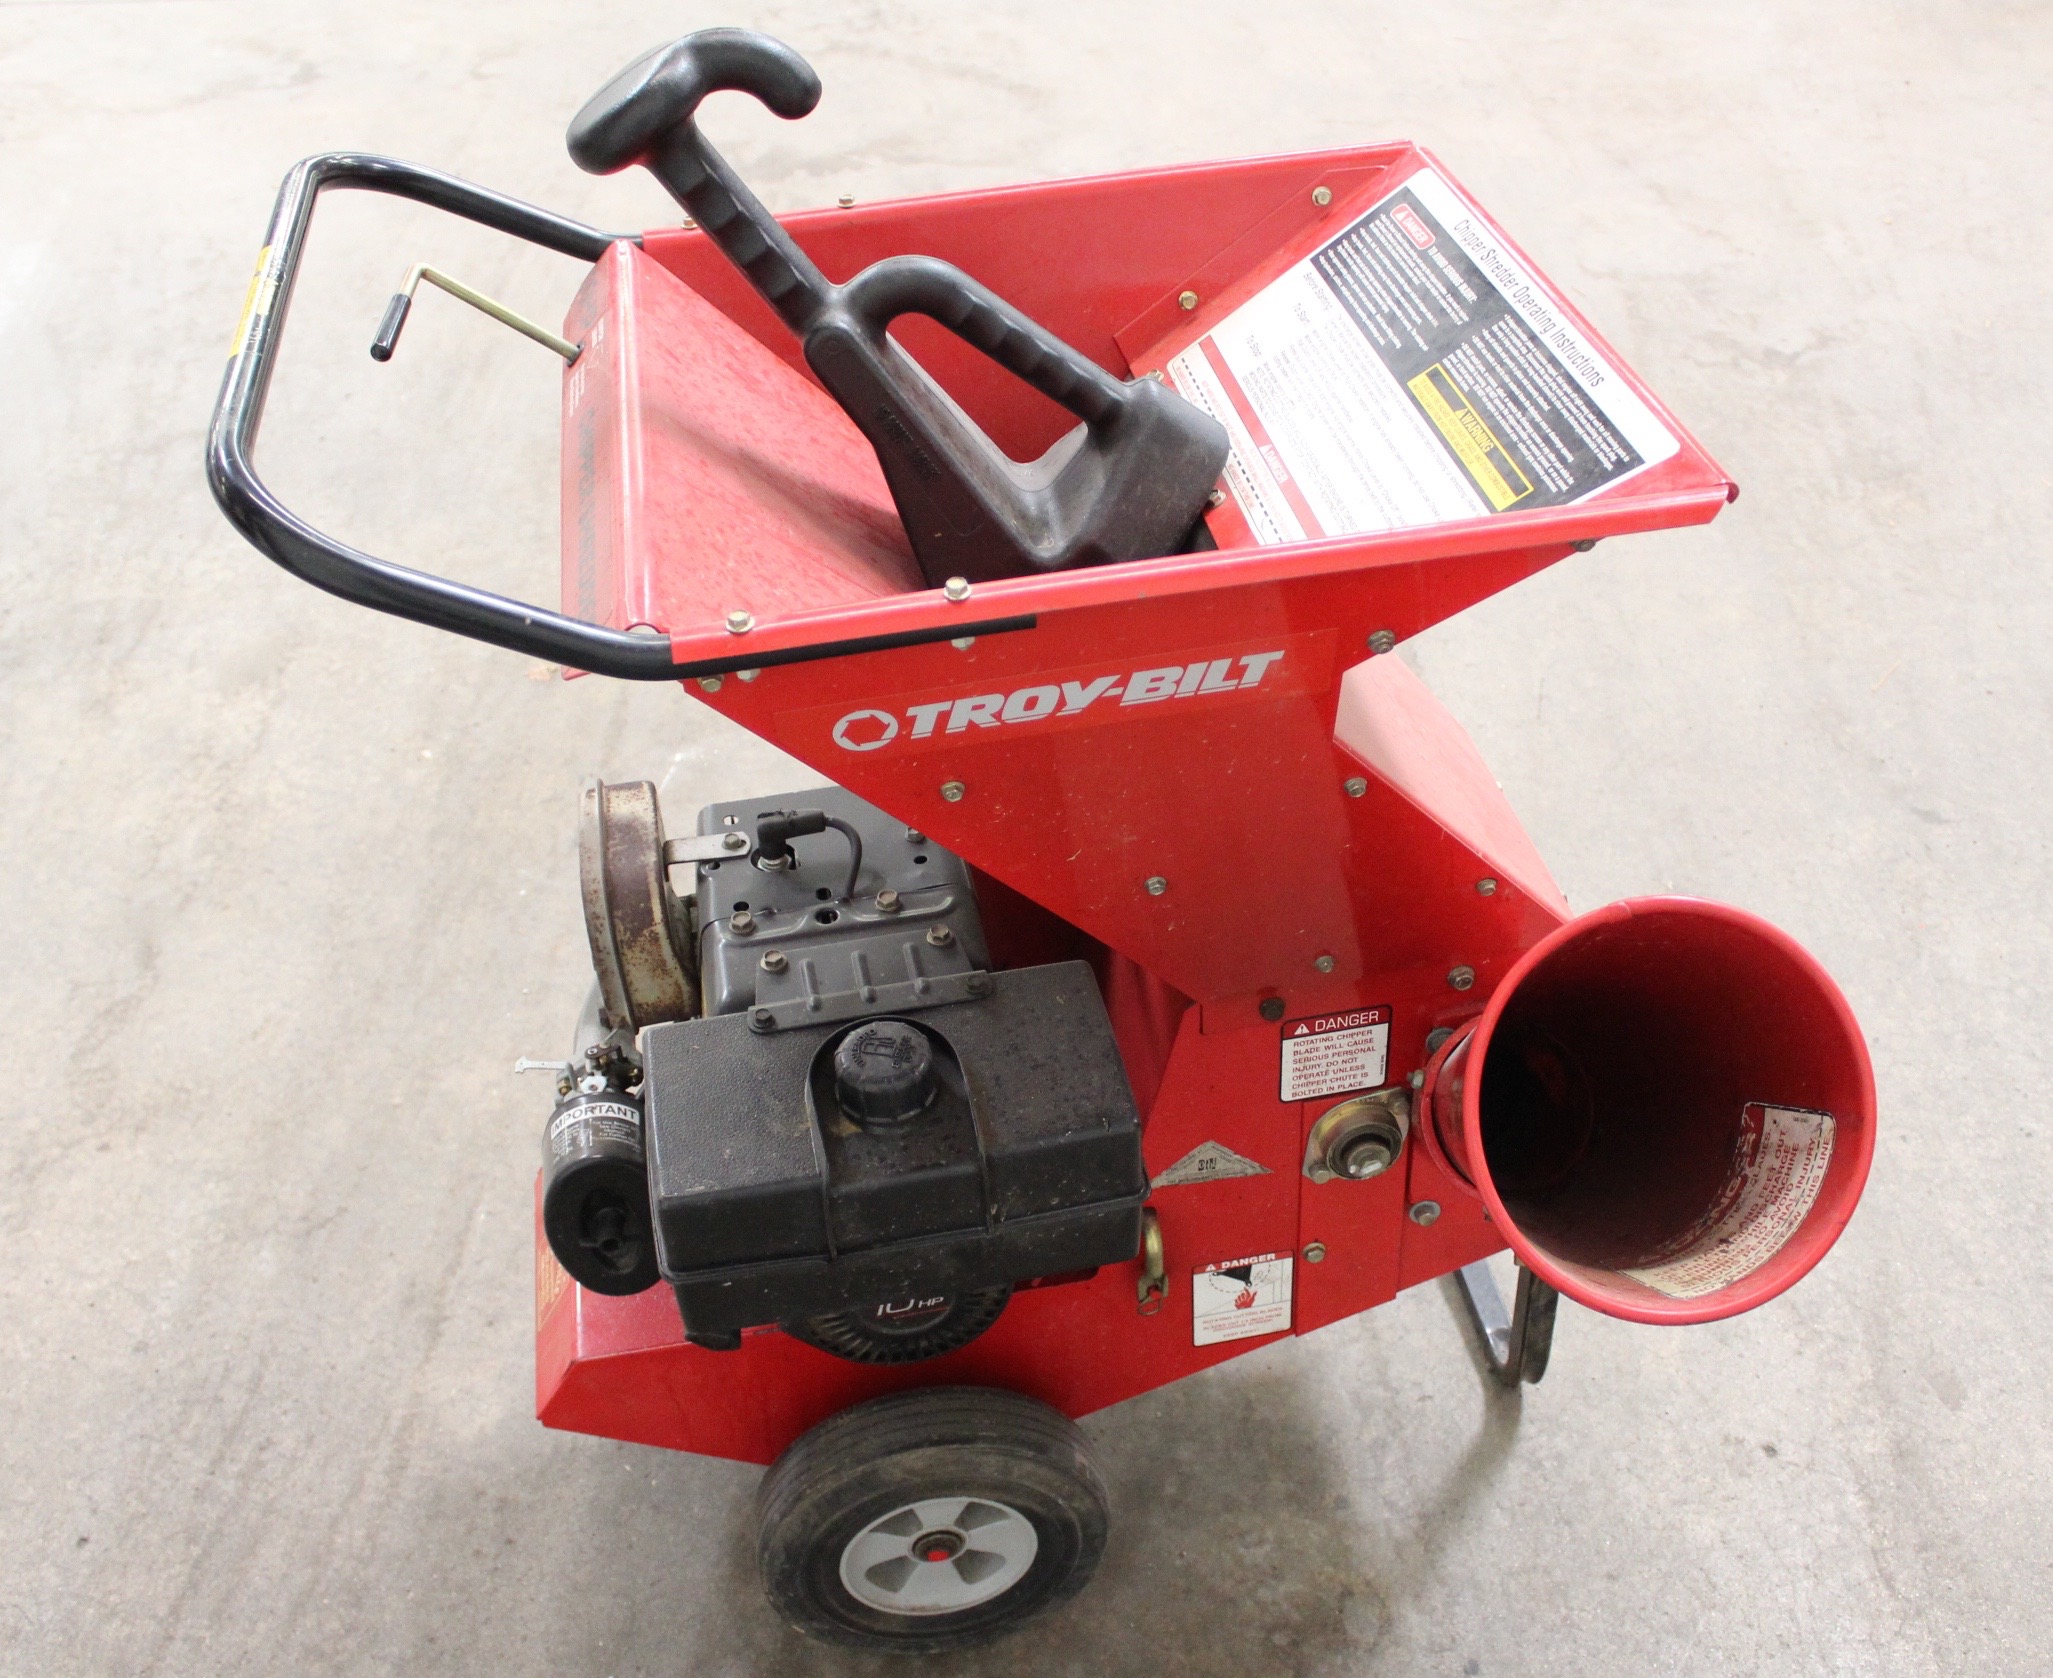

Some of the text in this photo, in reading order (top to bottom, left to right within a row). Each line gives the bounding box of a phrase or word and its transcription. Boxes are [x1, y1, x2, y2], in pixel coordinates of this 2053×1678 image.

[1401, 215, 1429, 244] DANGER
[1302, 270, 1320, 291] Before
[1507, 284, 1562, 336] Operating
[1545, 327, 1611, 388] Instructions
[1457, 412, 1498, 453] WARNING
[1262, 449, 1290, 484] DANGER
[905, 650, 1285, 740] TROY-BILT
[1314, 1010, 1379, 1032] DANGER
[1293, 1029, 1373, 1048] ROTATING CHIPPER
[1293, 1037, 1375, 1057] BLADE WILL CAUSE
[1292, 1045, 1377, 1065] SERIOUS PERSONAL
[1326, 1060, 1339, 1068] DO
[1341, 1056, 1359, 1065] NOT
[1291, 1071, 1369, 1090] CHIPPER CHUTE IS
[1292, 1069, 1330, 1082] OPERATE
[1332, 1063, 1366, 1075] UNLESS
[1291, 1088, 1324, 1098] BOLTED
[1337, 1080, 1367, 1091] PLACE.
[551, 1104, 637, 1136] IMPORTANT
[1757, 1163, 1777, 1199] FEET
[1773, 1128, 1787, 1159] OUT
[1769, 1141, 1800, 1206] MACHINE
[1749, 1143, 1791, 1224] DISCHARGE
[1800, 1173, 1820, 1205] THIS
[1751, 1224, 1769, 1239] TO
[1767, 1181, 1795, 1222] AVOID
[1741, 1194, 1797, 1258] PERSONAL
[1221, 1253, 1276, 1269] DANGER
[918, 1296, 944, 1308] HP
